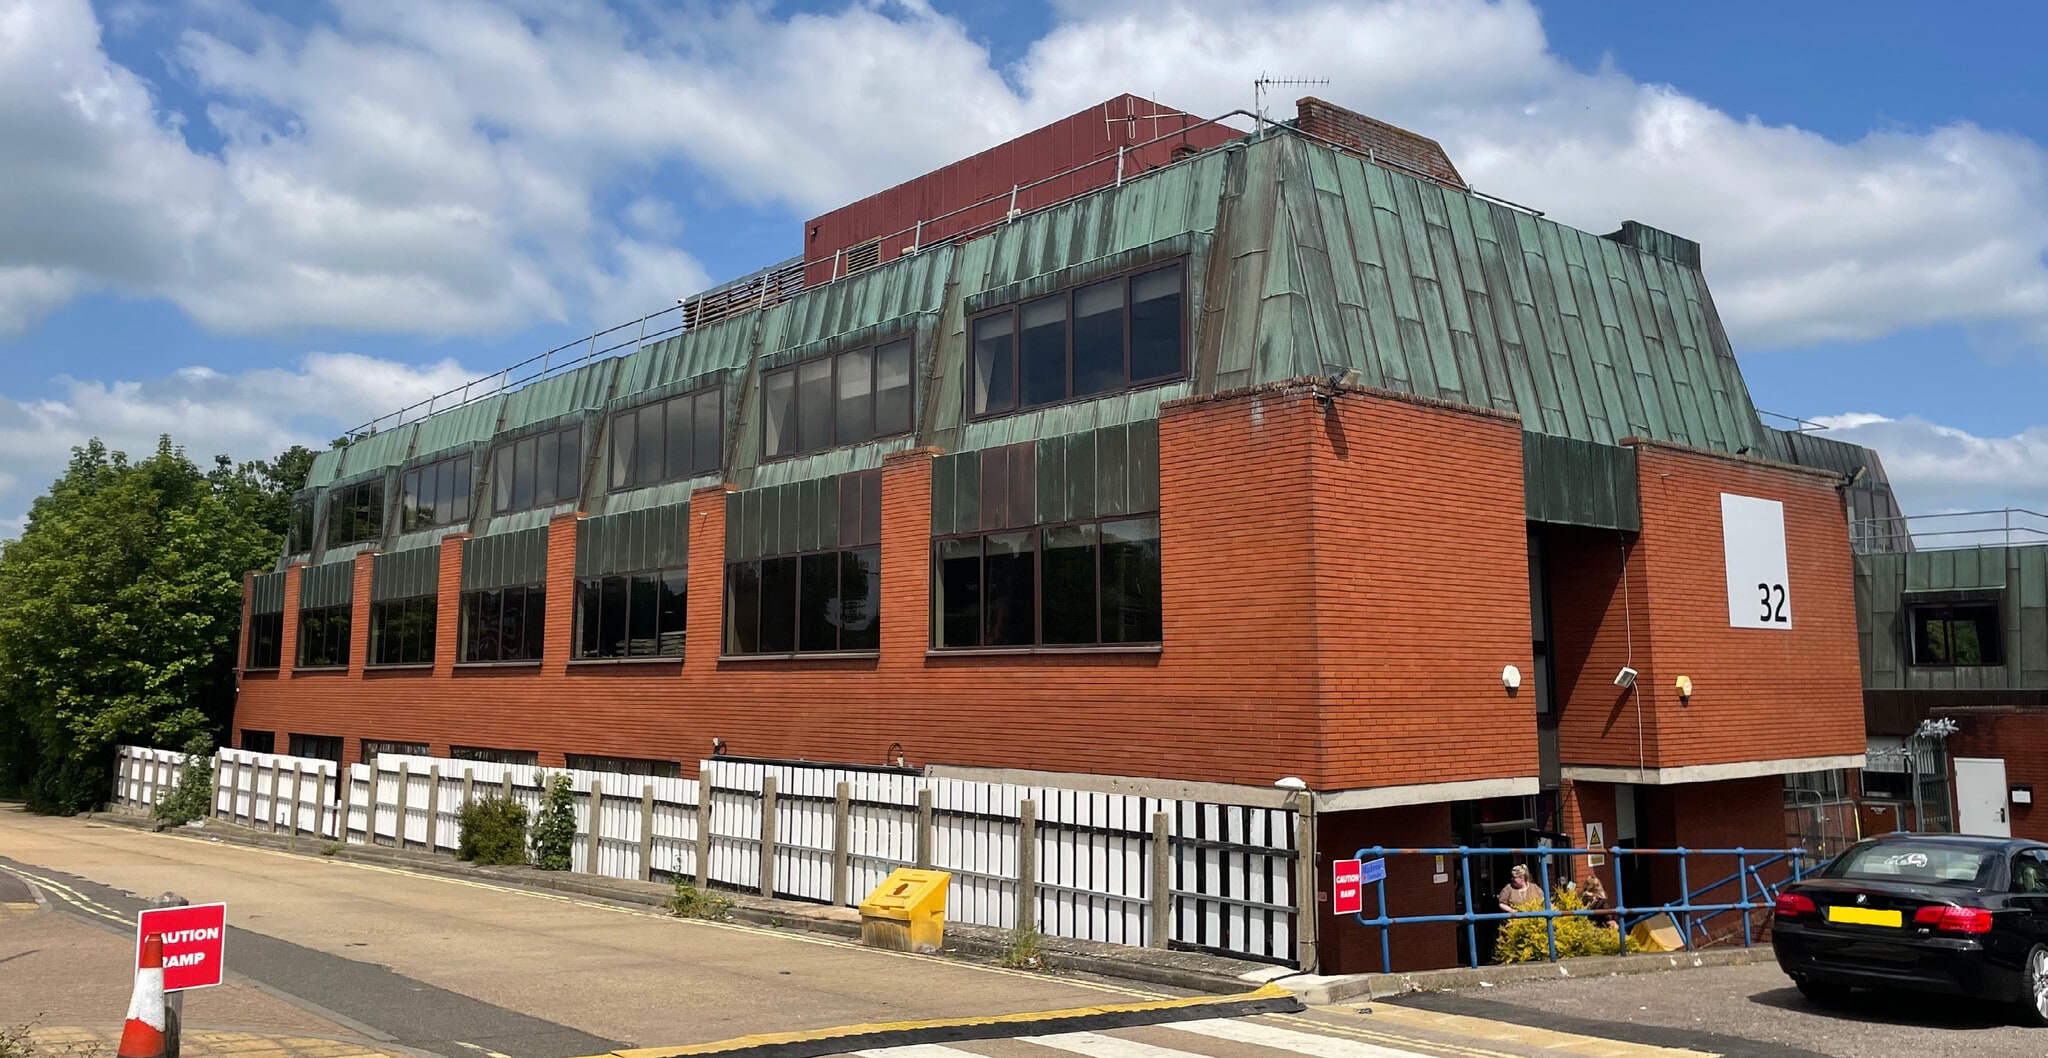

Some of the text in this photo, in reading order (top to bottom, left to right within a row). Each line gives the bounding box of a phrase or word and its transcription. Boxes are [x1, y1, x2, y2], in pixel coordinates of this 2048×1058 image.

[1758, 583, 1787, 622] 32
[1336, 874, 1360, 884] CAUTION
[144, 927, 219, 944] AUTION
